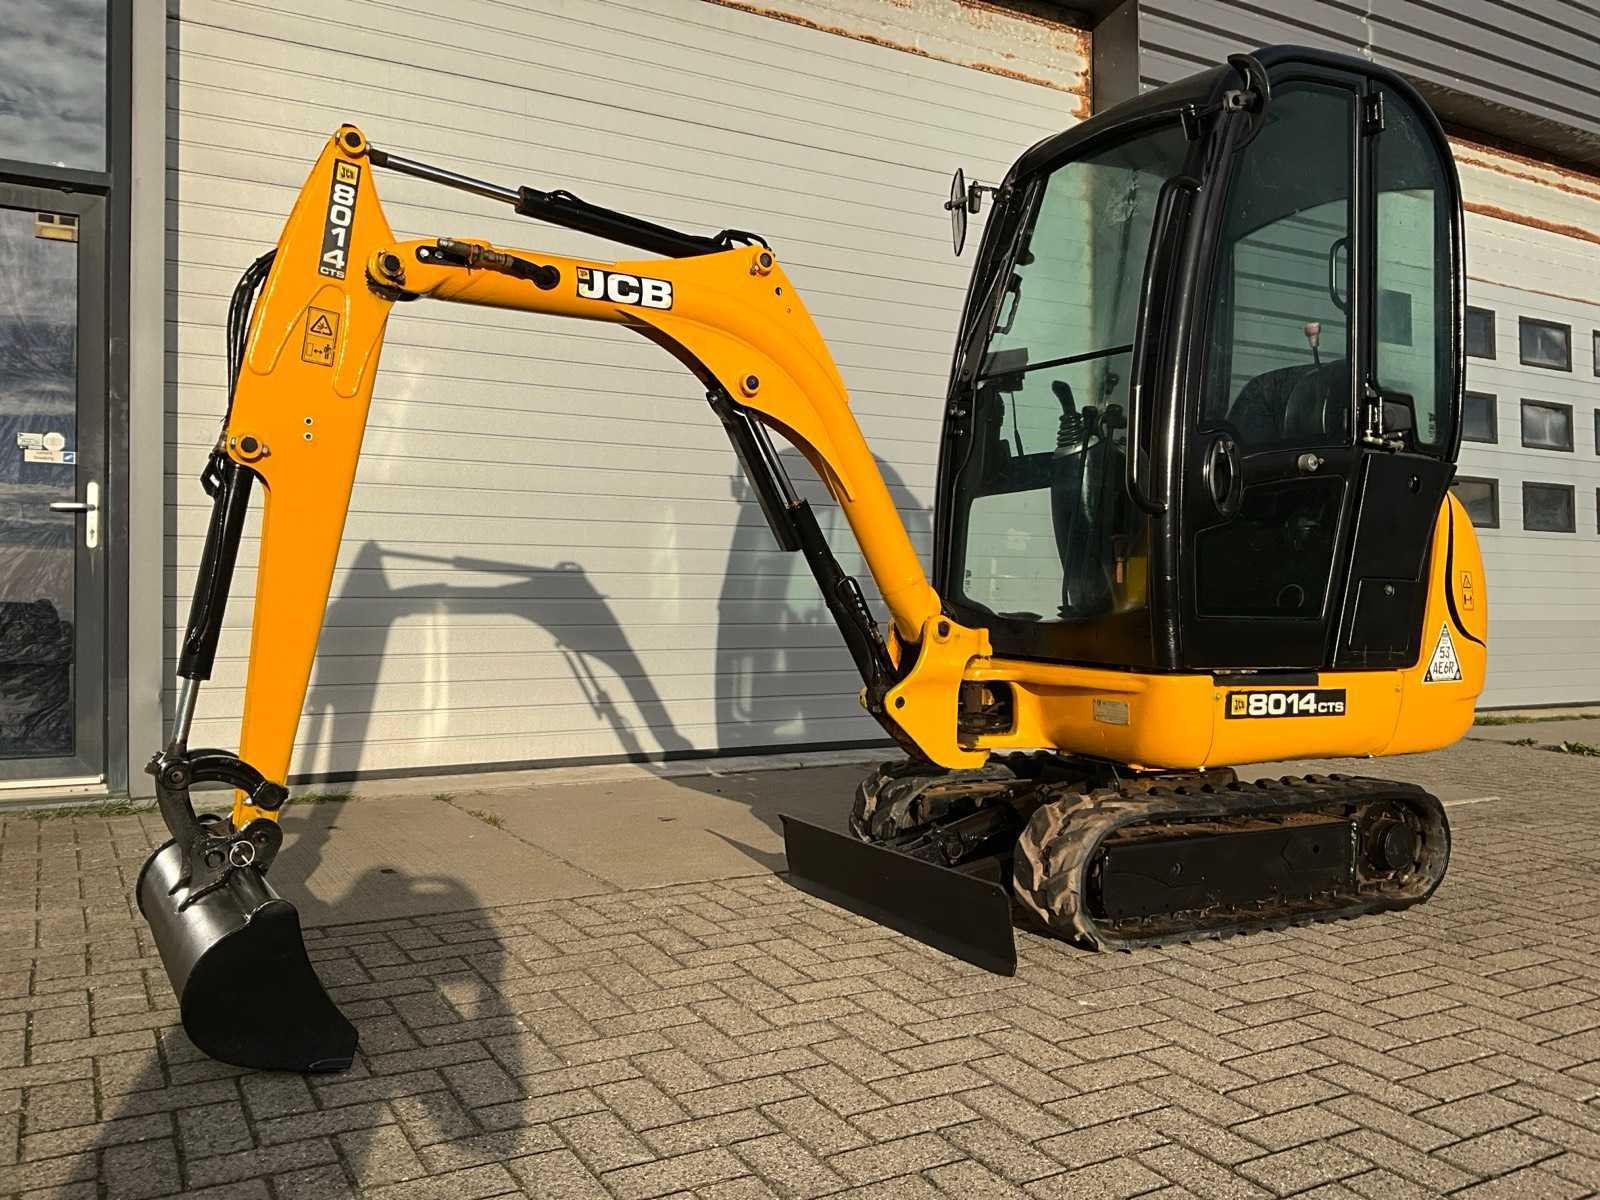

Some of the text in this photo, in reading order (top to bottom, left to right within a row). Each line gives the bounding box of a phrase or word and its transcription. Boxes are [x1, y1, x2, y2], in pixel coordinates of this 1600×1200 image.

[323, 183, 356, 269] 8014
[320, 266, 344, 279] CTS
[578, 269, 673, 310] JCB
[1439, 645, 1451, 659] 53
[1248, 692, 1317, 715] 8014
[1318, 702, 1344, 713] CTS
